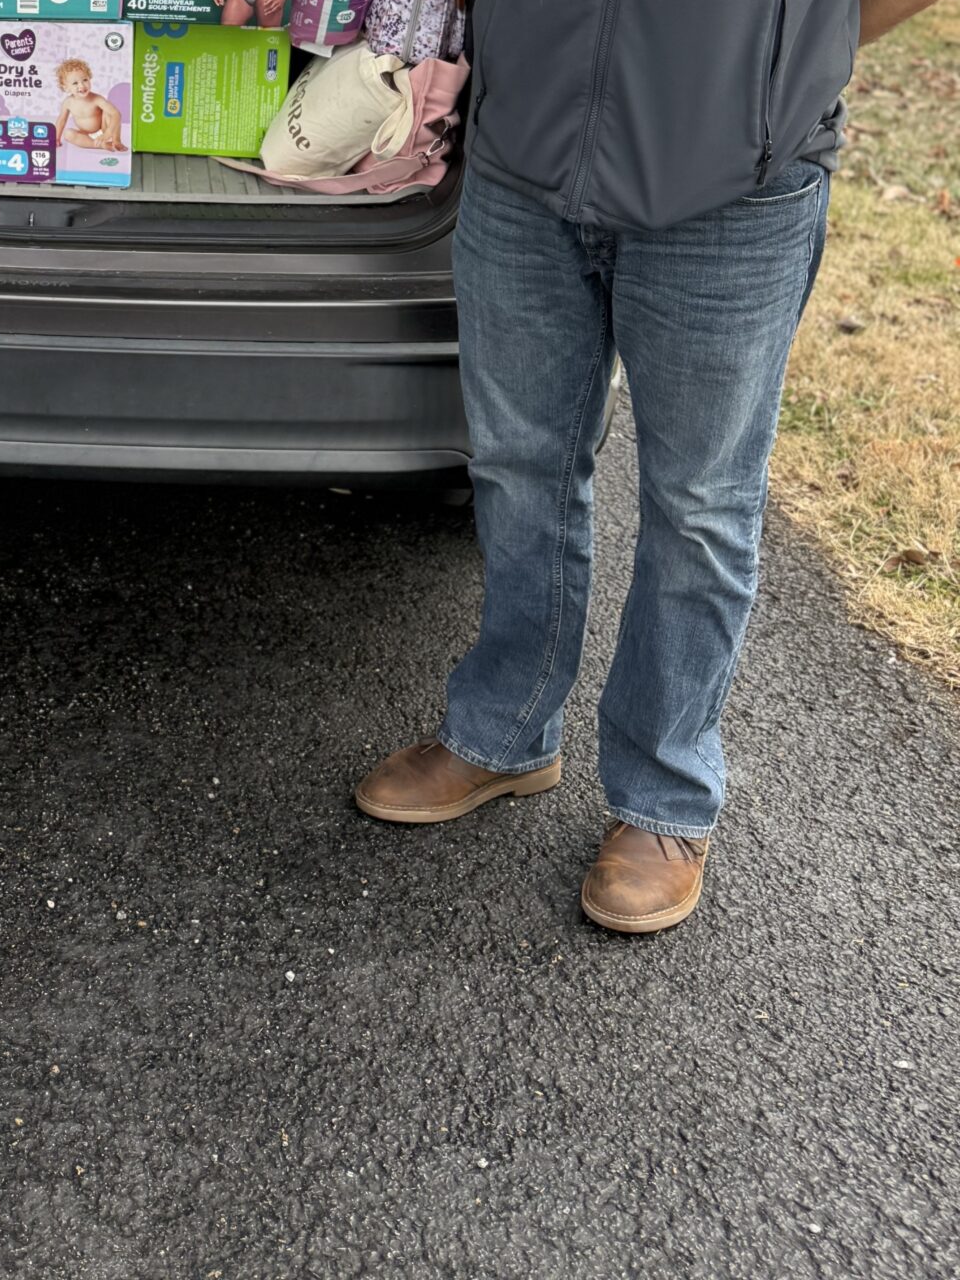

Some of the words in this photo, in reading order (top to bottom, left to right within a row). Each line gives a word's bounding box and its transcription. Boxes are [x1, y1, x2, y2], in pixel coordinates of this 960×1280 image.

[4, 34, 33, 49] Parent's
[10, 46, 32, 55] CHOICE
[29, 64, 39, 76] &
[7, 153, 24, 171] 4
[10, 279, 70, 288] TOYOTA
